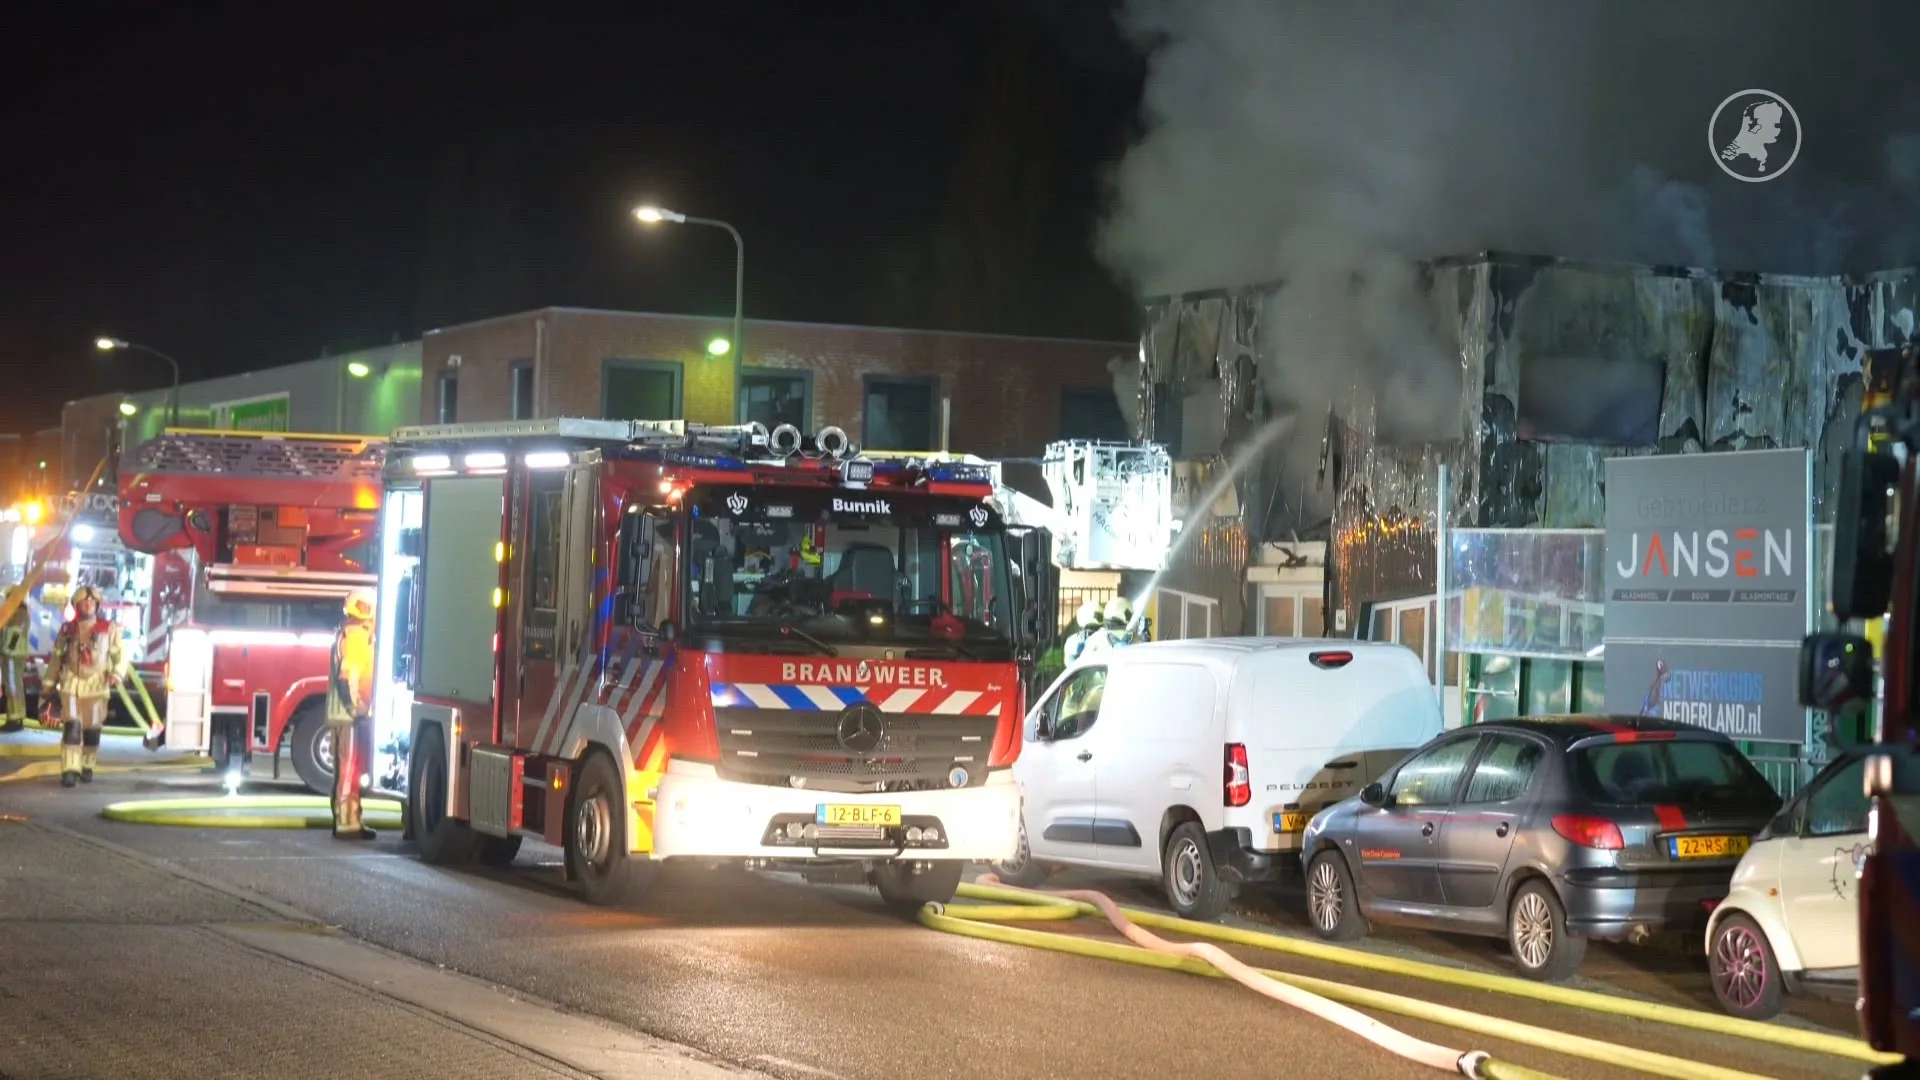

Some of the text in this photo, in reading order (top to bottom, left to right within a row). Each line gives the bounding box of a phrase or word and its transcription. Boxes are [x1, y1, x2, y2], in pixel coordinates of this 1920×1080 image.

[832, 498, 891, 514] Bunnik
[1616, 528, 1792, 578] JANSEN
[782, 662, 943, 685] BRANDWEER
[1661, 669, 1764, 702] NETWERKGIDS
[1663, 700, 1762, 735] NEDERLAND.nl
[1266, 781, 1354, 791] PEUGEOT
[832, 807, 892, 822] 12-BLF-6
